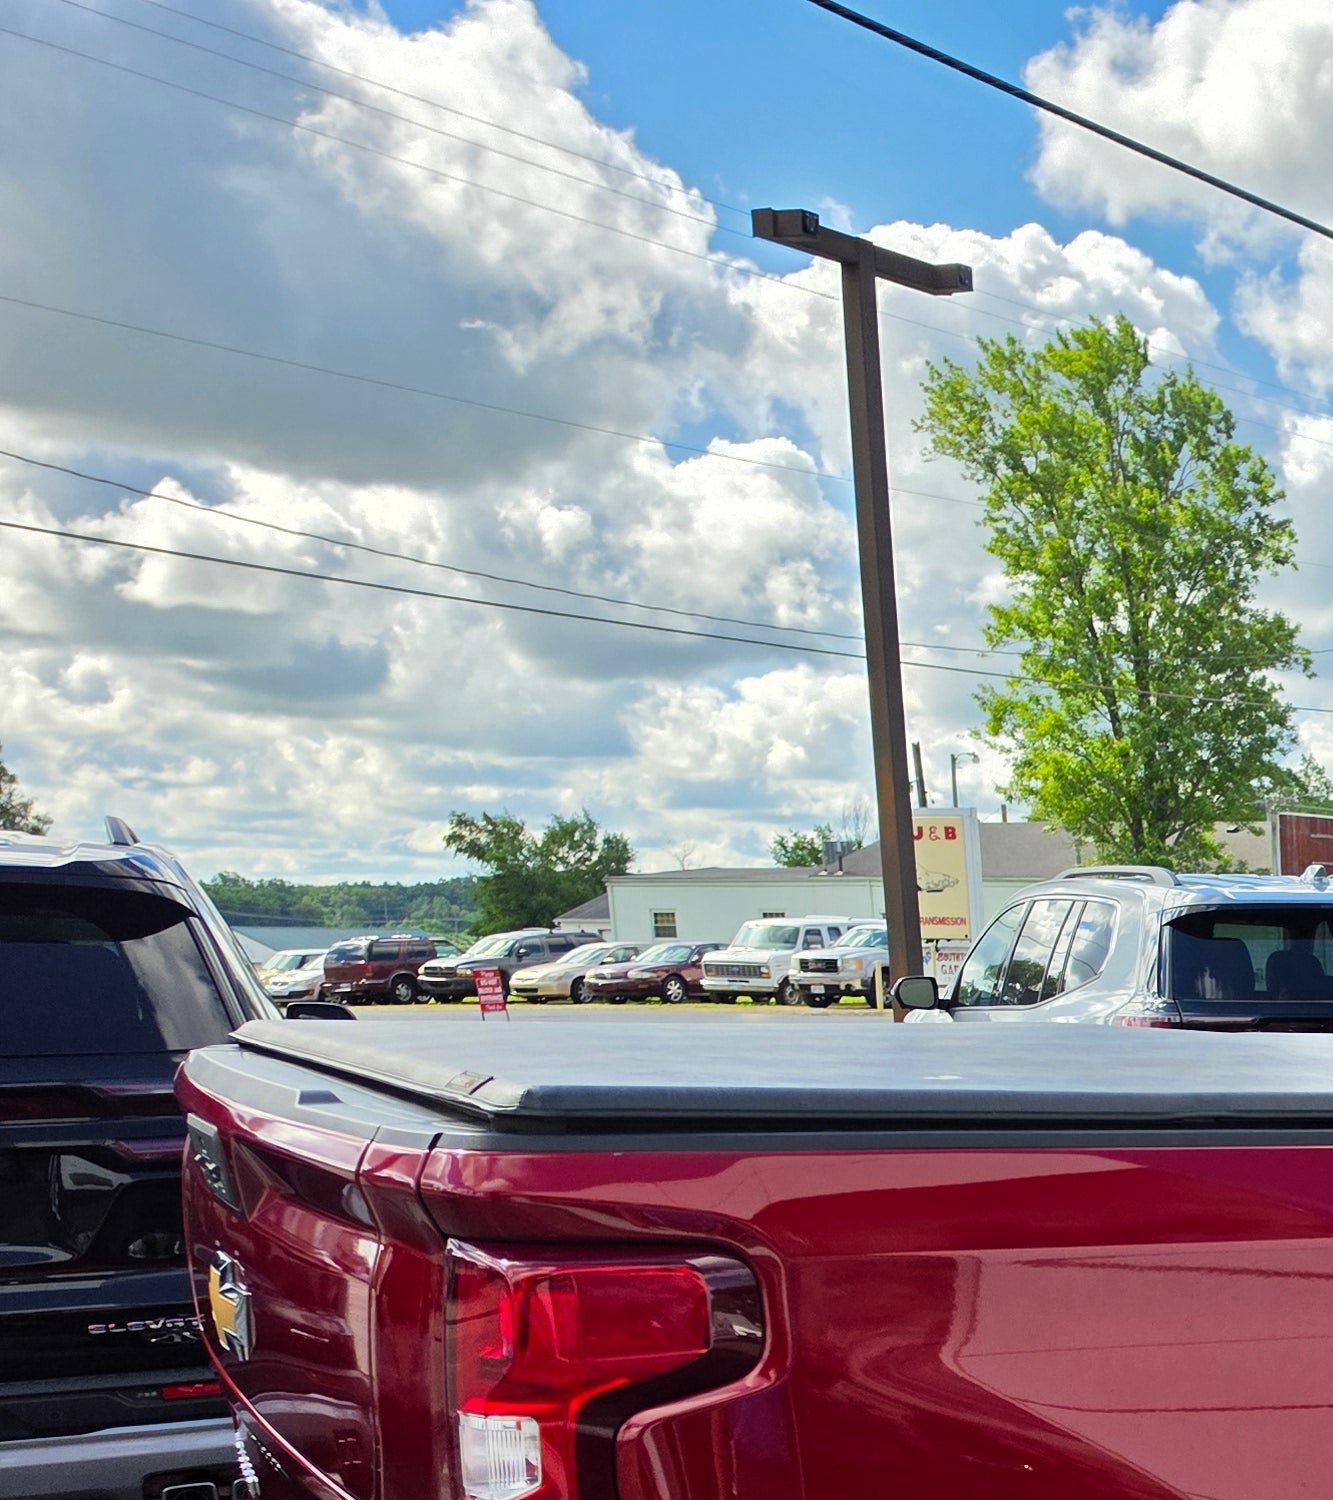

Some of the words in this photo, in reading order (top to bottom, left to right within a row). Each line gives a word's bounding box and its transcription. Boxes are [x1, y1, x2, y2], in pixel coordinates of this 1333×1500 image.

[929, 825, 941, 841] &
[944, 826, 957, 840] B
[919, 916, 967, 926] RANSMISSION
